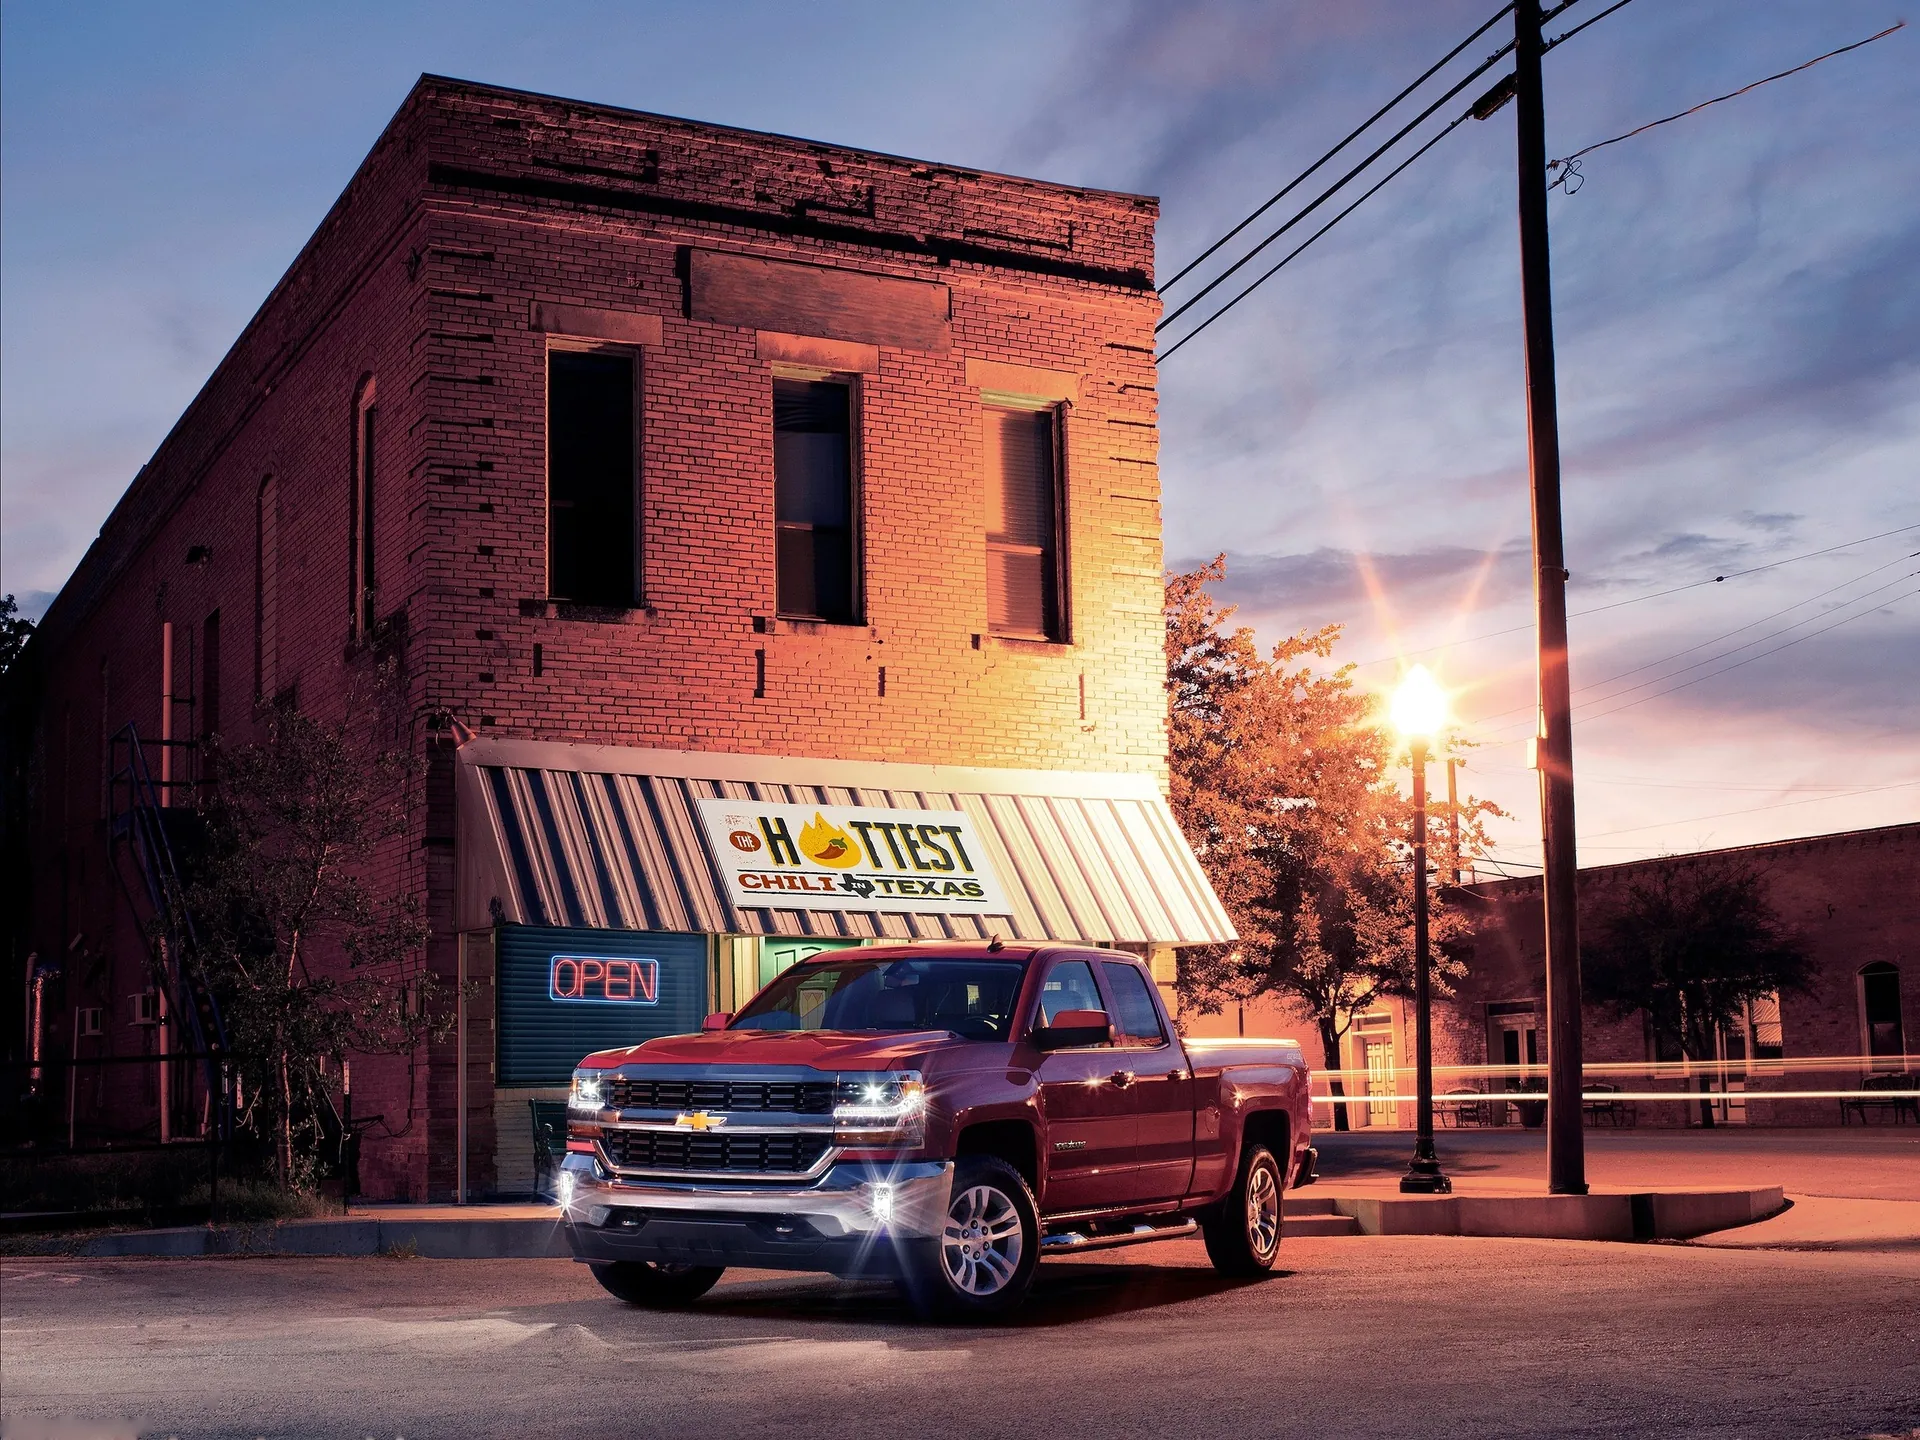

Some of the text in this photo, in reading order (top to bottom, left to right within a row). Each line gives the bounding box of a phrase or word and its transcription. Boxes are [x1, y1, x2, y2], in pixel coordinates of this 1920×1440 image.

[735, 835, 755, 848] THE
[738, 874, 836, 891] CHILI
[874, 879, 985, 897] TEXAS
[554, 959, 655, 1000] OPEN
